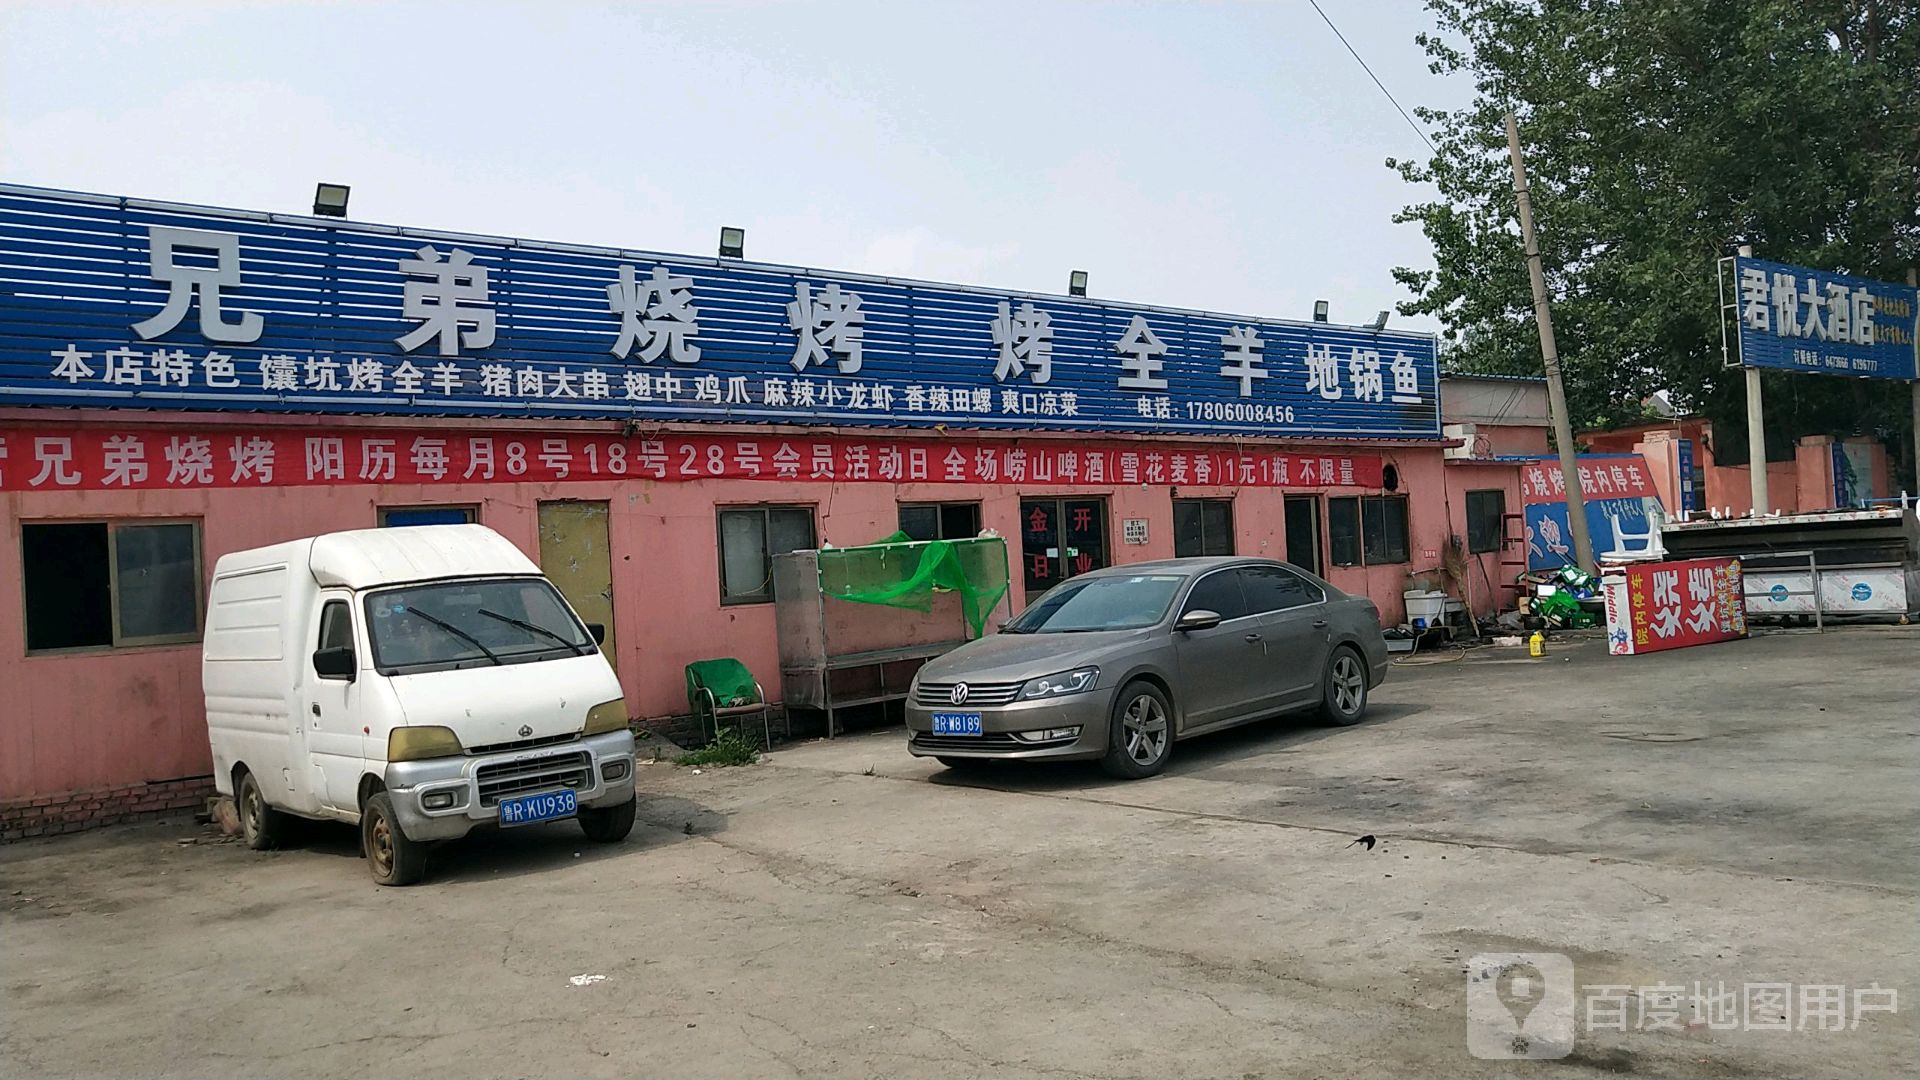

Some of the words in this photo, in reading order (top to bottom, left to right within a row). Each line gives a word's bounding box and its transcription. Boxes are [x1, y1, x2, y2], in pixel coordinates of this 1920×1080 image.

[131, 226, 865, 375] 兄弟烧烤
[989, 301, 1269, 398] 烤全羊
[1303, 343, 1423, 405] 地锅鱼
[1740, 268, 1876, 346] 君悦大酒店
[50, 344, 240, 388] 本店特色
[480, 364, 610, 401] 猪肉大串
[622, 370, 682, 403] 翅中
[694, 373, 751, 405] 鸡爪
[763, 377, 894, 411] 麻辣小龙虾
[904, 384, 992, 414] 香辣田螺
[1001, 388, 1079, 416] 爽口凉菜
[1186, 401, 1294, 424] 17806008456
[0, 434, 276, 487] 兄弟烧烤
[1300, 457, 1356, 486] 不限量
[1523, 467, 1567, 496] 烧烤
[1577, 465, 1645, 494] 院内停车
[1631, 573, 1649, 645] 院内停车
[1649, 568, 1720, 639] 烧烤
